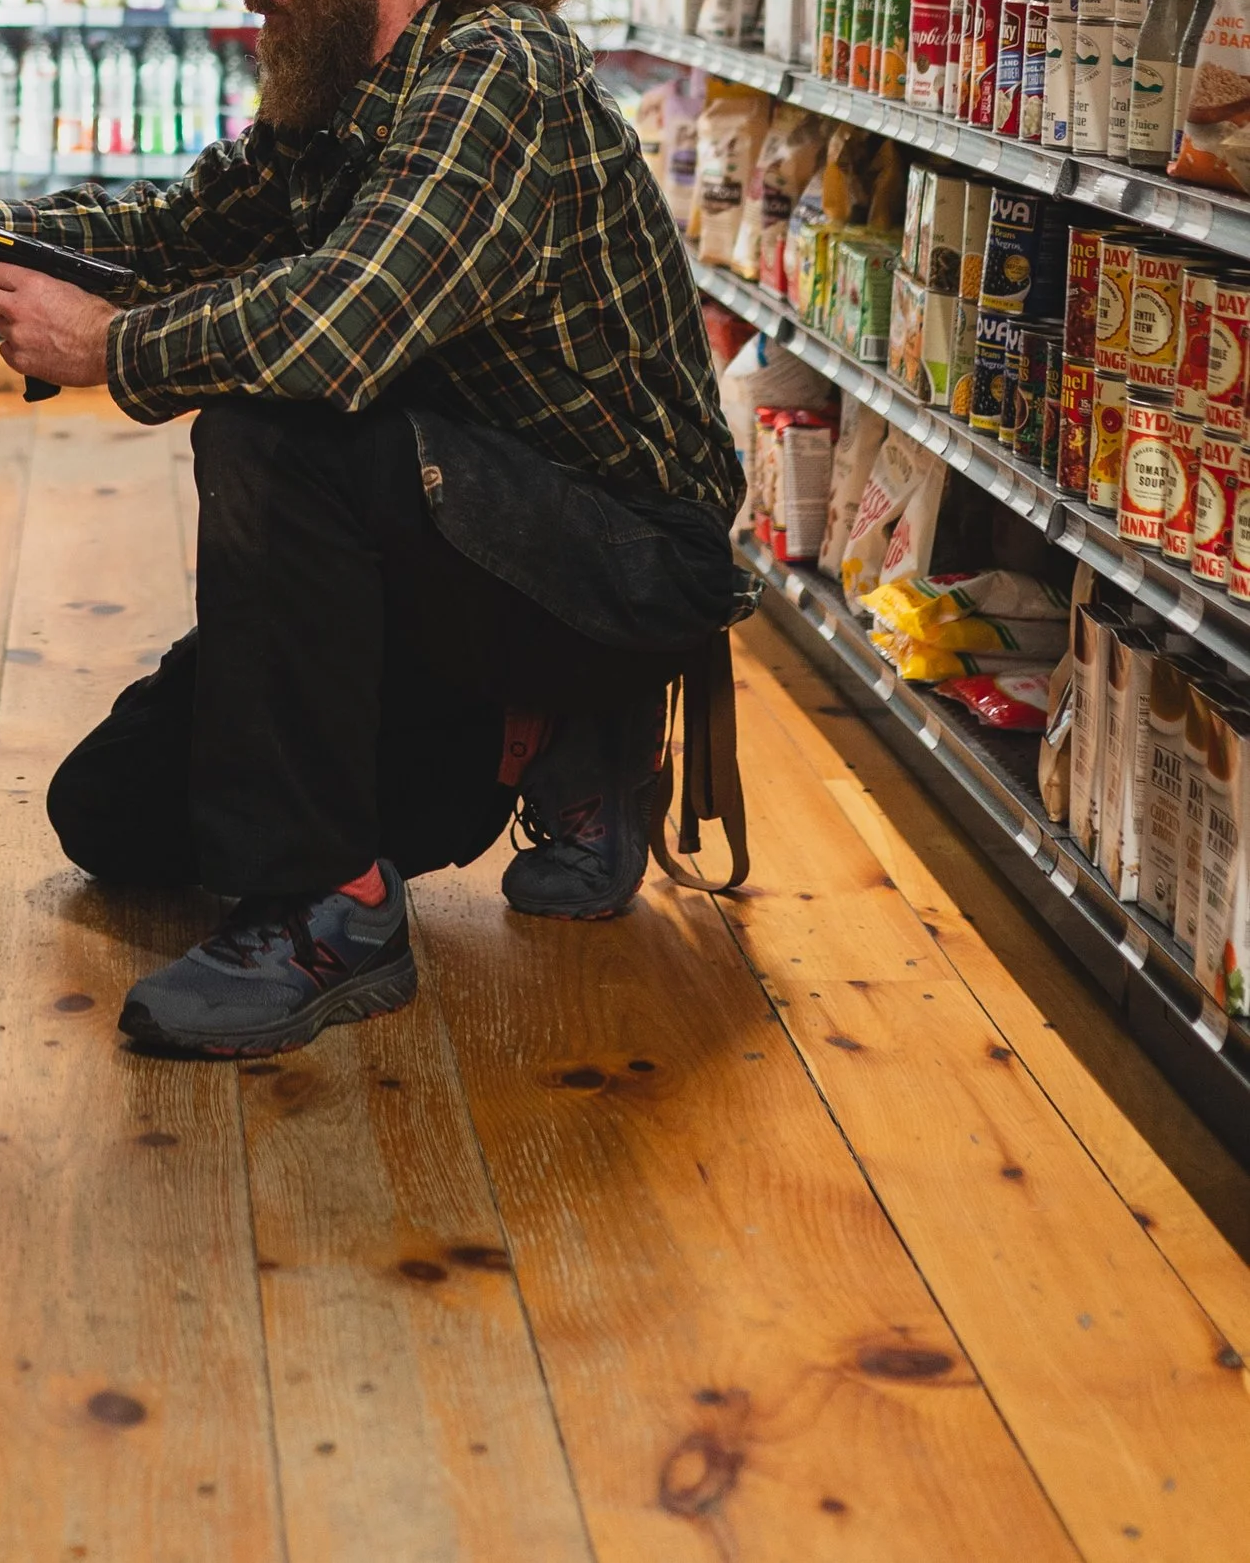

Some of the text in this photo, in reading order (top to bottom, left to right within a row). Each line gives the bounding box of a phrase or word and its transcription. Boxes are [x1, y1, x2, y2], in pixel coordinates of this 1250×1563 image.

[1135, 118, 1159, 131] Juice
[994, 228, 1016, 240] Beans
[1103, 247, 1132, 268] DAY
[1138, 476, 1166, 489] SOUP
